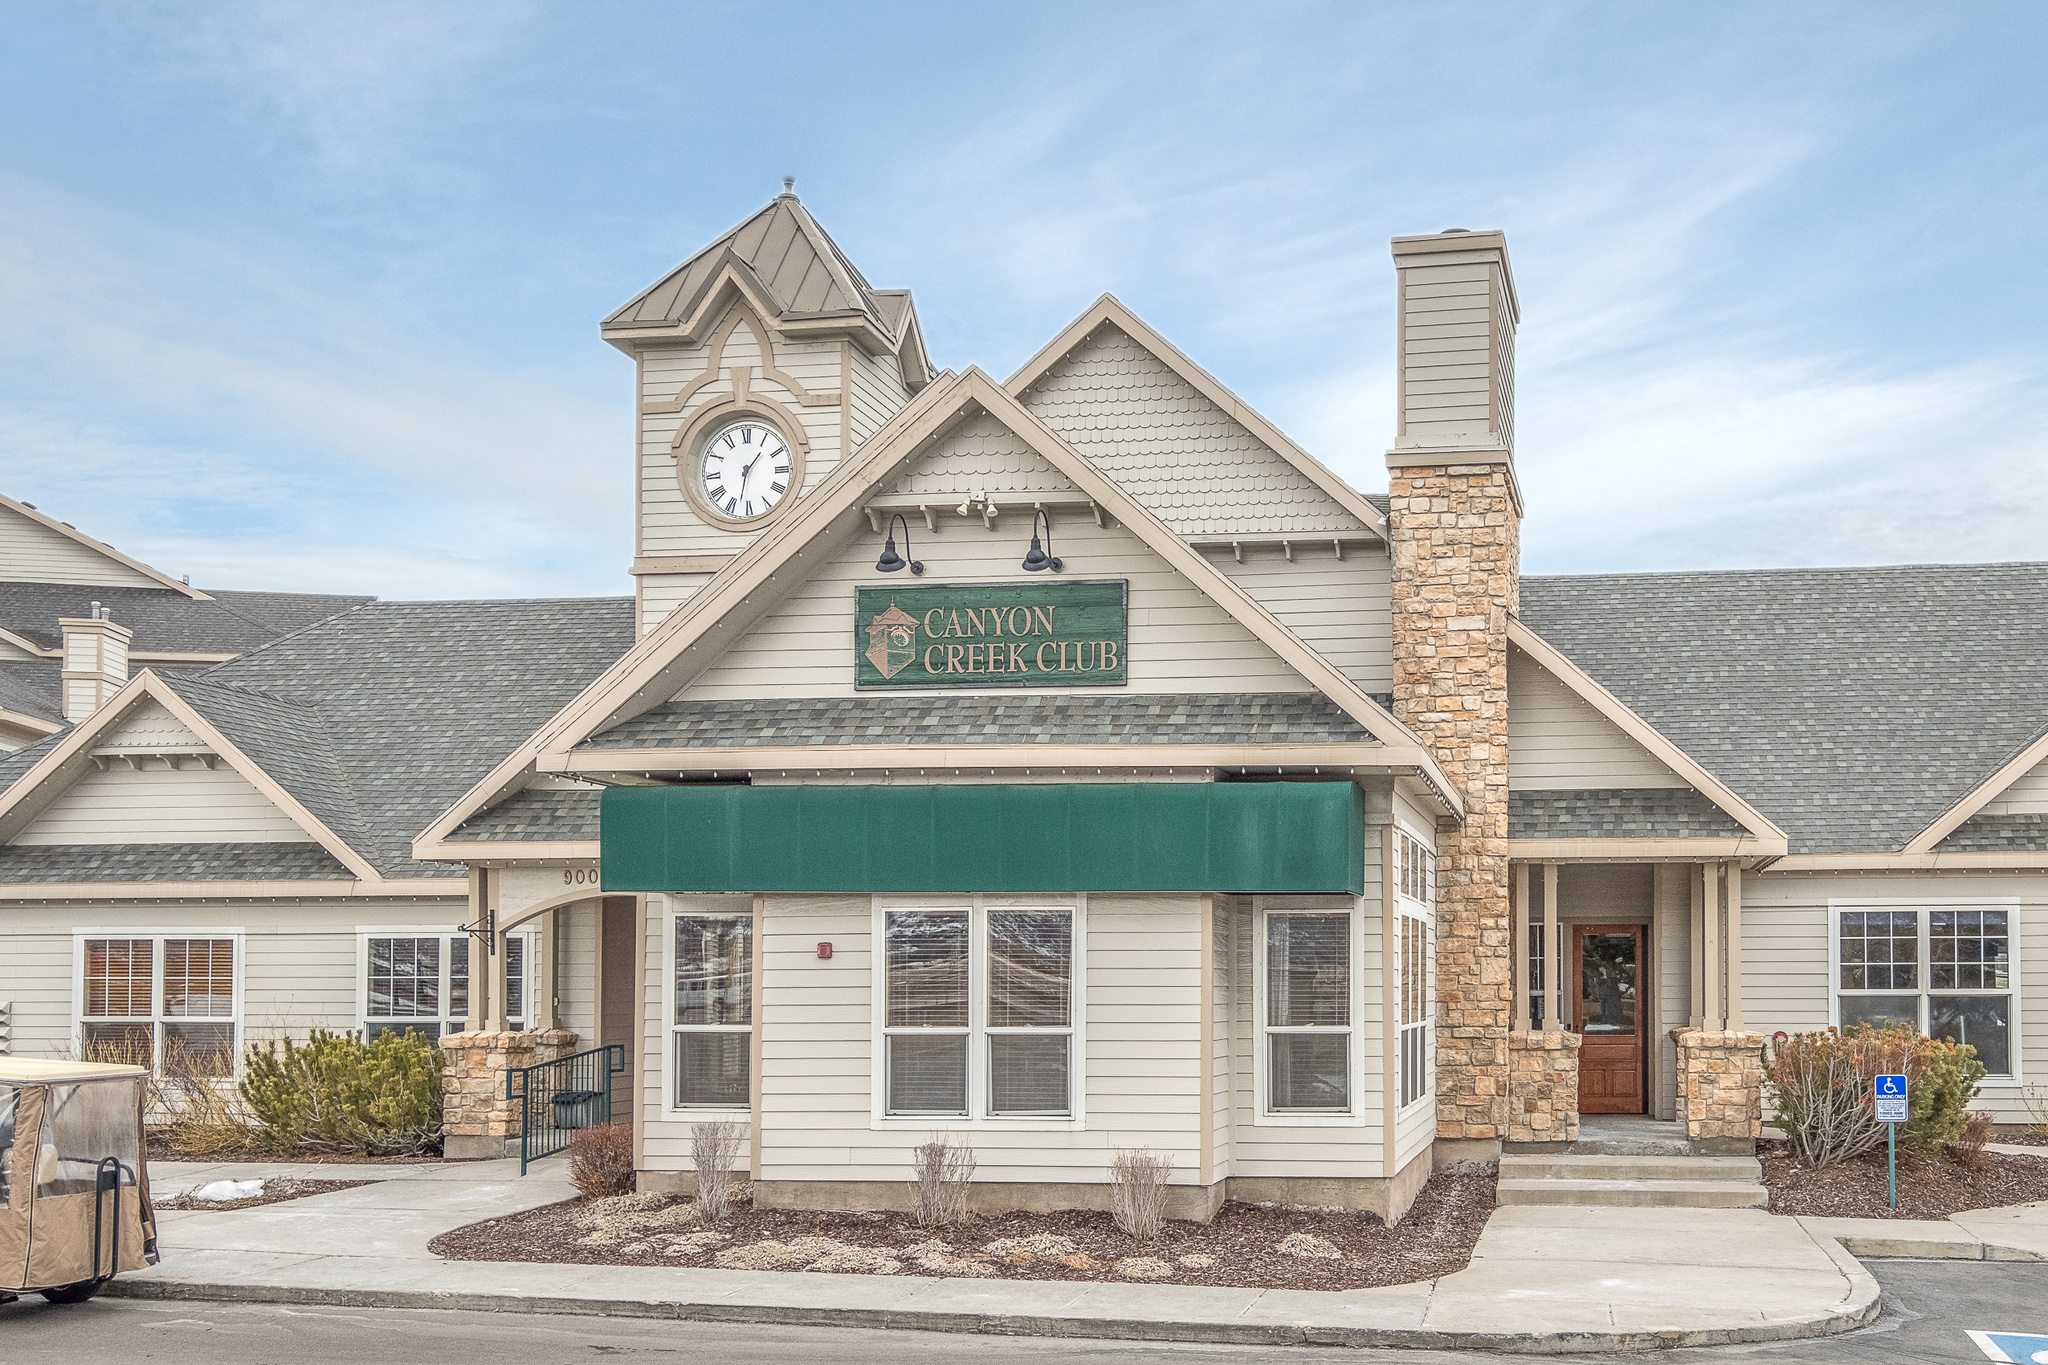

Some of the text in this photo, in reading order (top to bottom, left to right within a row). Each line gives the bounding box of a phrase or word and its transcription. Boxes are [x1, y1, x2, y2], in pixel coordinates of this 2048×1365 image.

[742, 428, 752, 444] XII
[770, 446, 784, 458] II
[775, 465, 789, 474] III
[923, 605, 1056, 639] CANYON
[924, 640, 1118, 674] CREEK CLUB
[564, 868, 598, 885] 900
